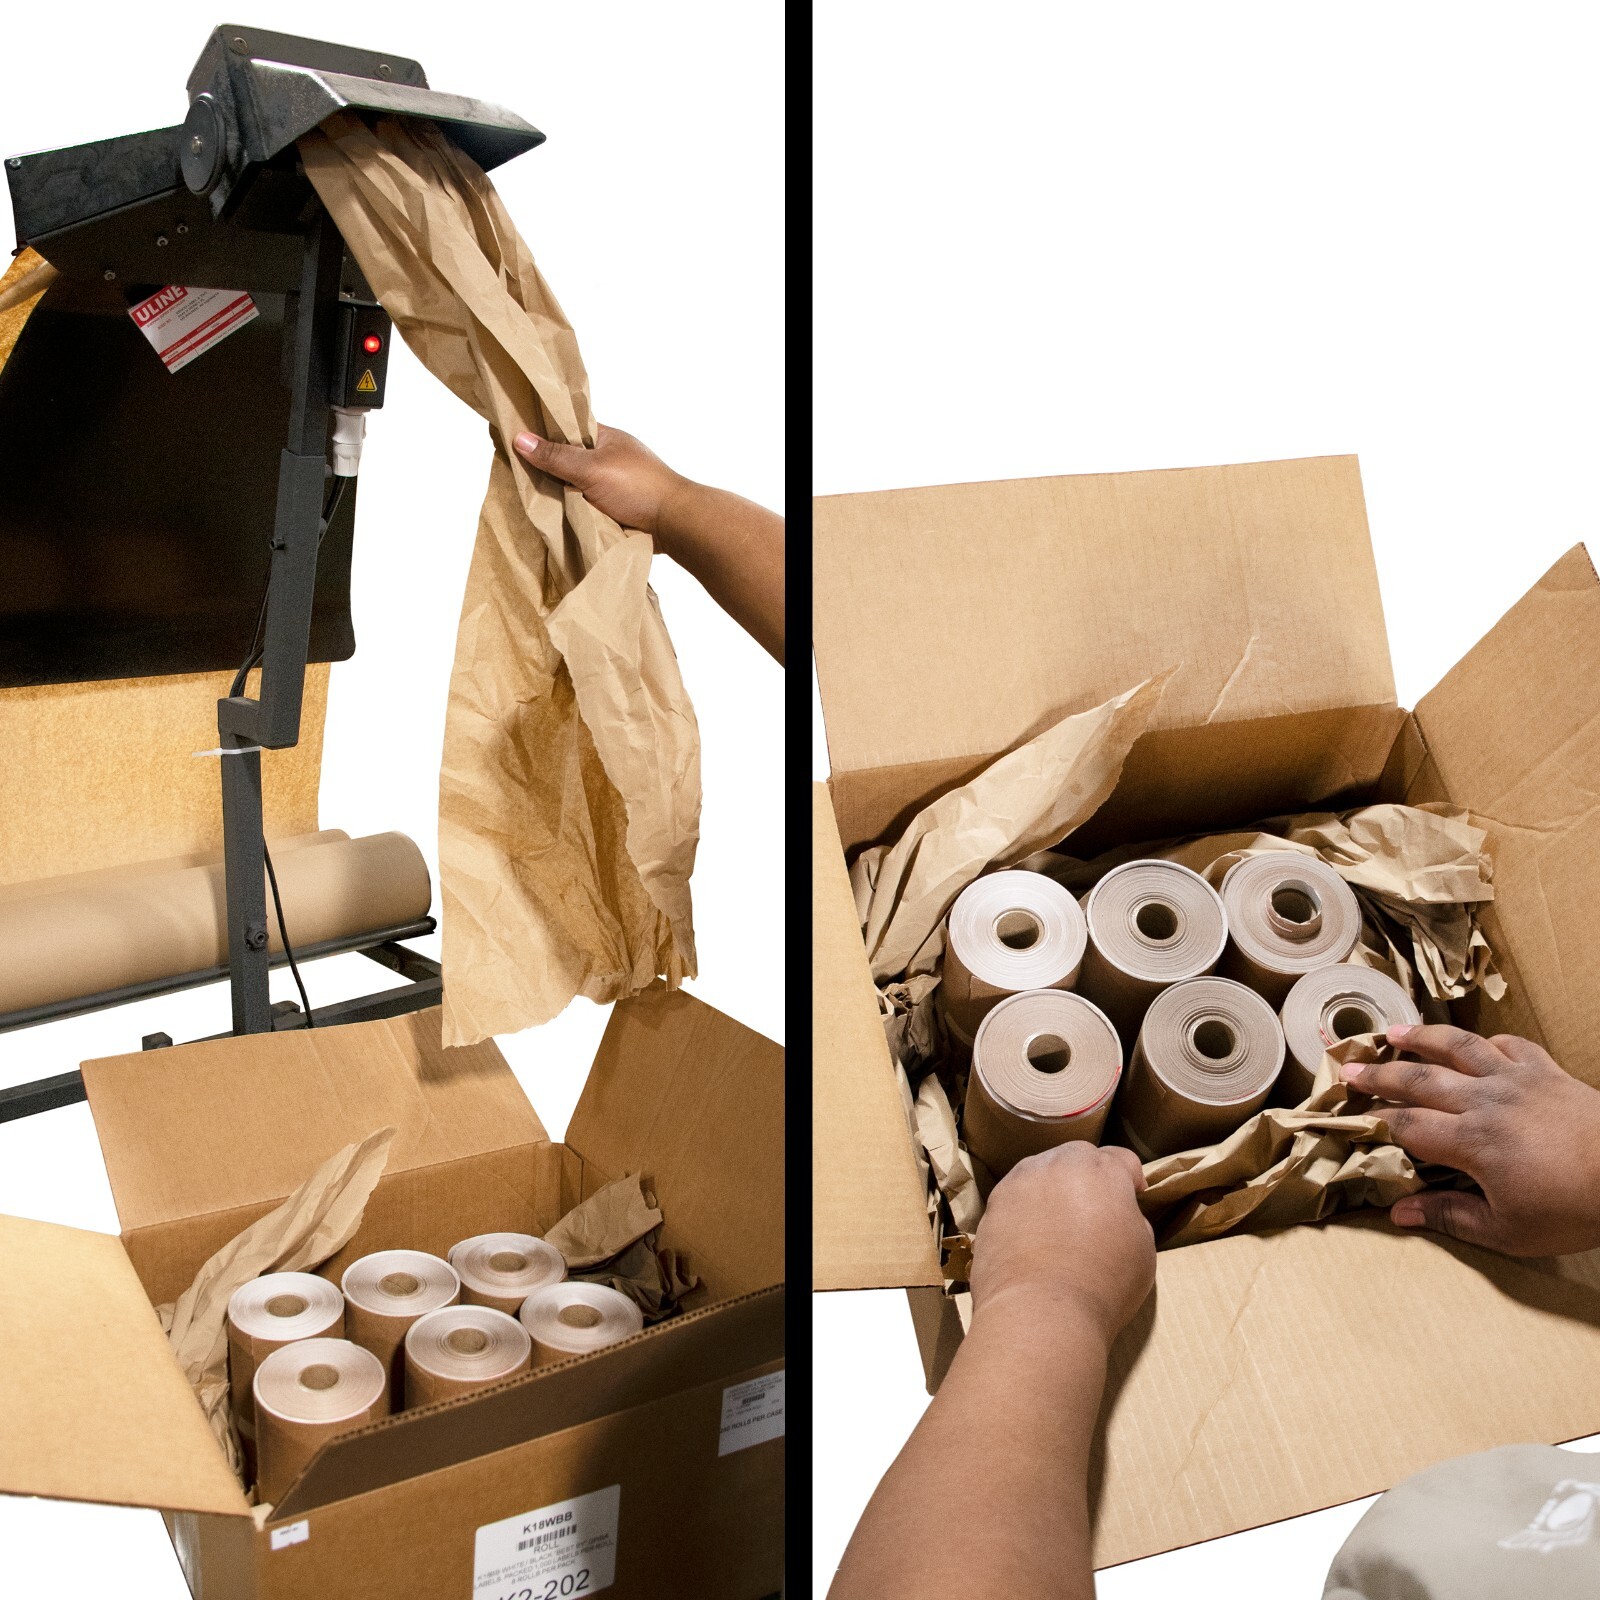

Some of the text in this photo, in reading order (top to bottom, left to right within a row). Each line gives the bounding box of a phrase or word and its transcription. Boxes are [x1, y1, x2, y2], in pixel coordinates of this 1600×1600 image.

[136, 285, 184, 322] ULINE
[766, 1408, 783, 1418] CASE
[523, 1511, 573, 1535] K18WBB
[534, 1540, 559, 1554] ROLL
[499, 1568, 590, 1600] 2-202
